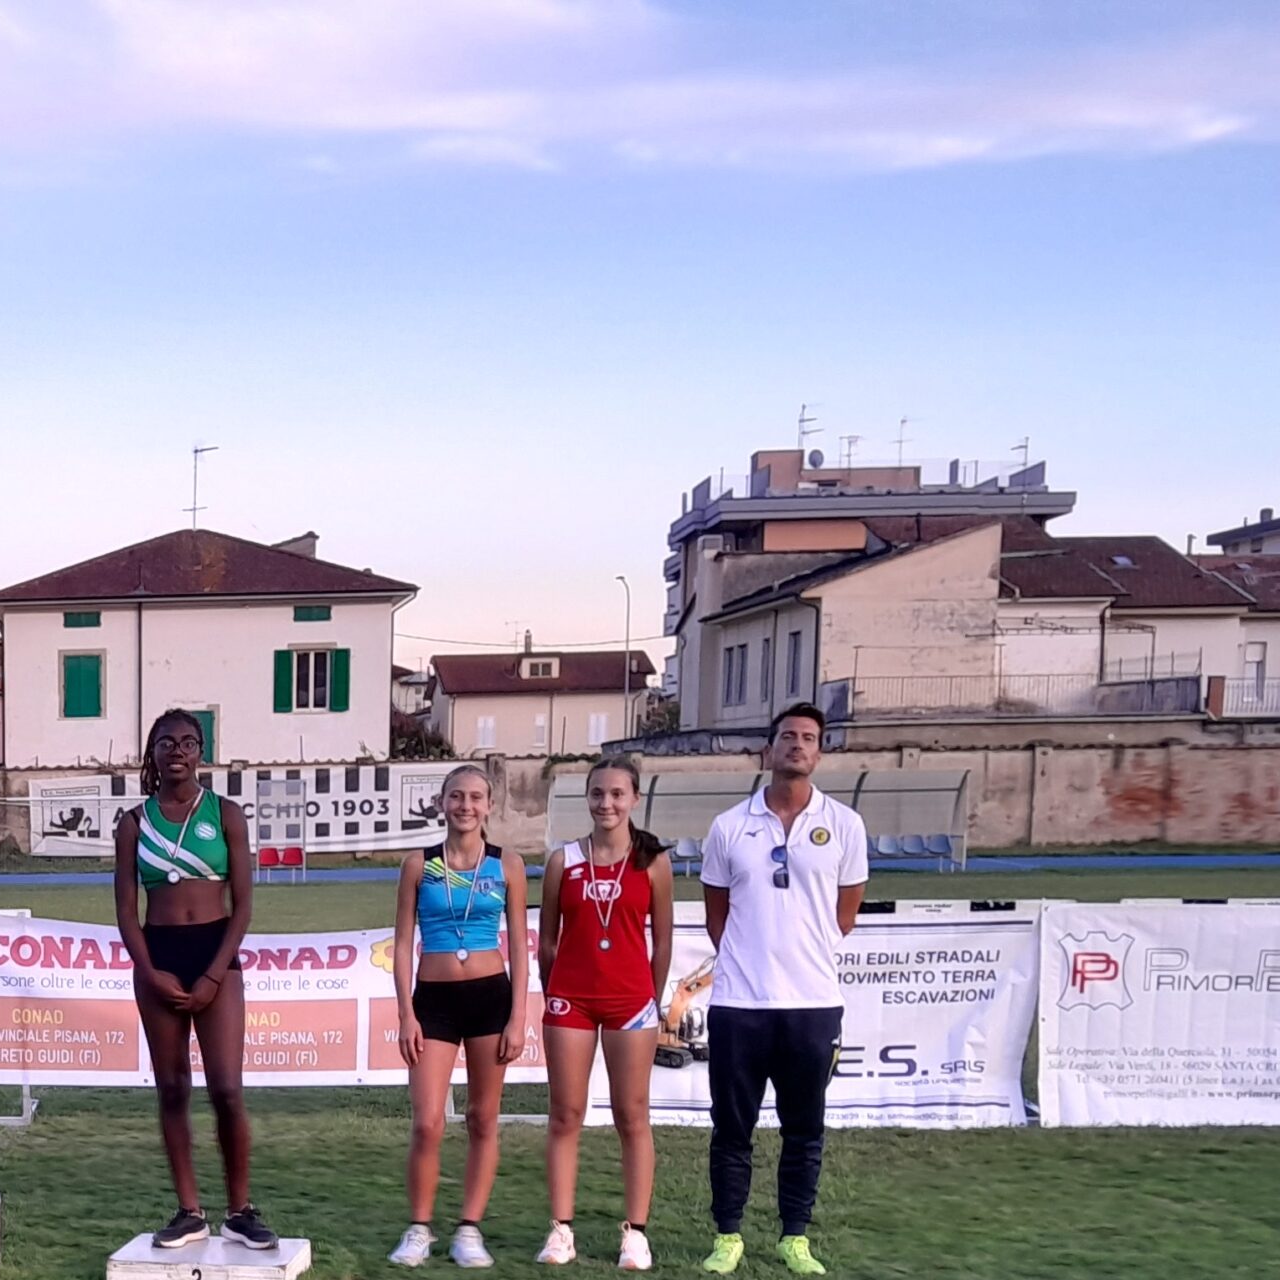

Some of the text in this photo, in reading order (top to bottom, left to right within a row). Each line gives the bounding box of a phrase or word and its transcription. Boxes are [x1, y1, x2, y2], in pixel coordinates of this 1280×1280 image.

[241, 799, 390, 820] CCHIO 1903
[834, 949, 1001, 966] ORI EDILI STRADALI
[41, 973, 75, 990] oltre
[81, 974, 93, 989] le
[99, 978, 131, 990] cose
[257, 975, 292, 992] oltre
[298, 976, 310, 991] le
[316, 976, 349, 990] cose
[941, 969, 997, 984] TERRA
[882, 988, 995, 1005] ESCAVAZIONI
[12, 1008, 64, 1024] CONAD
[247, 1012, 280, 1027] NAD
[54, 1030, 101, 1046] PISANA,
[105, 1031, 126, 1044] 172
[270, 1031, 318, 1047] PISANA,
[323, 1031, 344, 1044] 172
[38, 1049, 74, 1064] GUIDI
[79, 1048, 102, 1066] (FI)
[254, 1051, 290, 1066] GUIDI
[295, 1050, 319, 1067] (FI)
[519, 1046, 539, 1062] FI)
